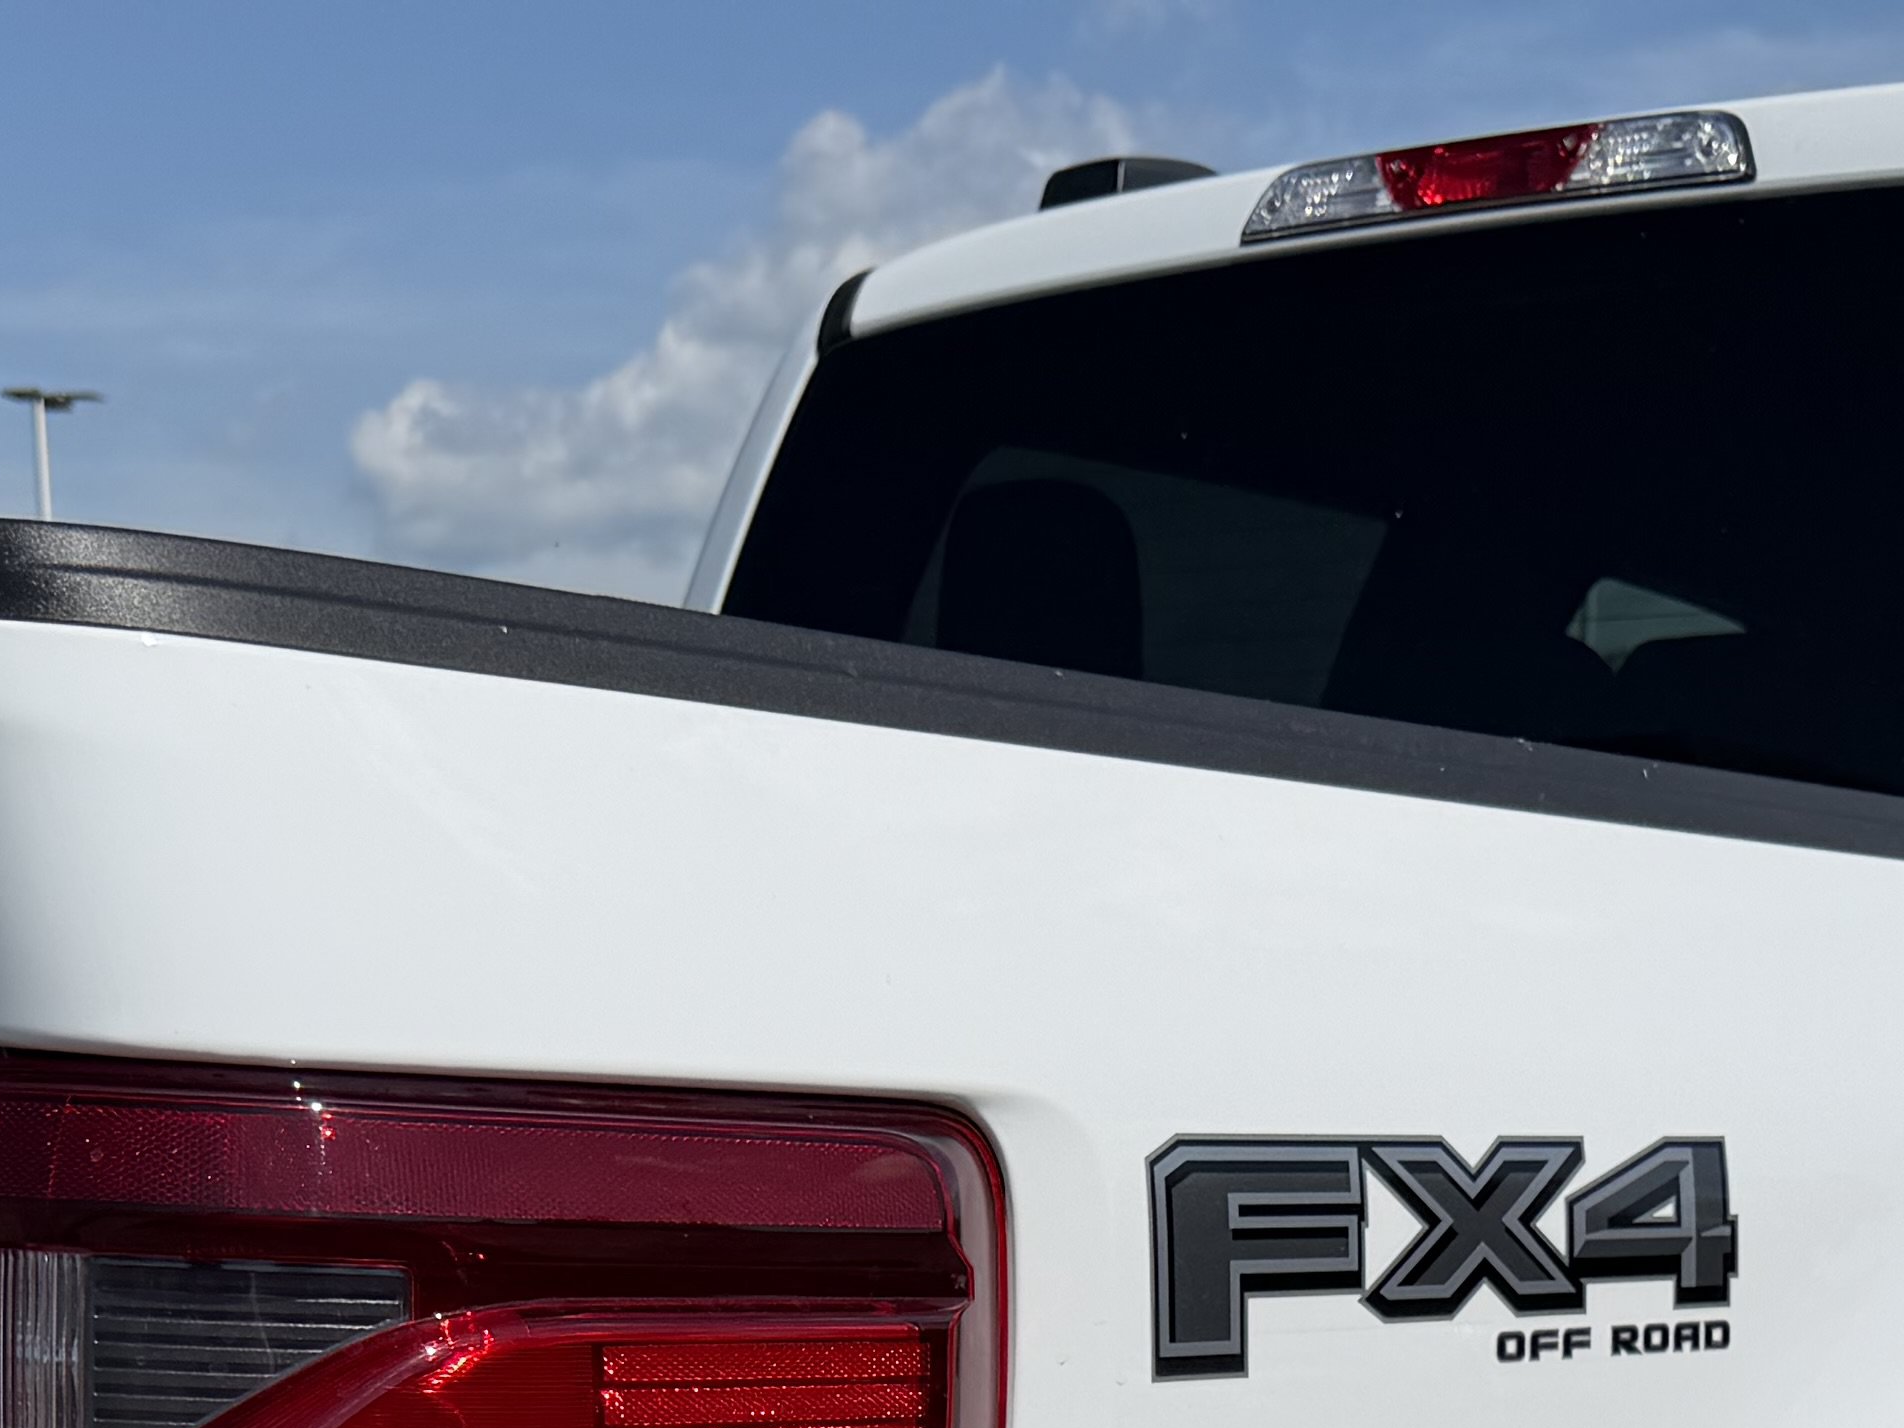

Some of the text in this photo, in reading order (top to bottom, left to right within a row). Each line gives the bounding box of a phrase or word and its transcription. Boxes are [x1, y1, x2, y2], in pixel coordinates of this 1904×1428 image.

[1145, 1133, 1738, 1383] FX4
[1496, 1319, 1731, 1364] OFF ROAD
